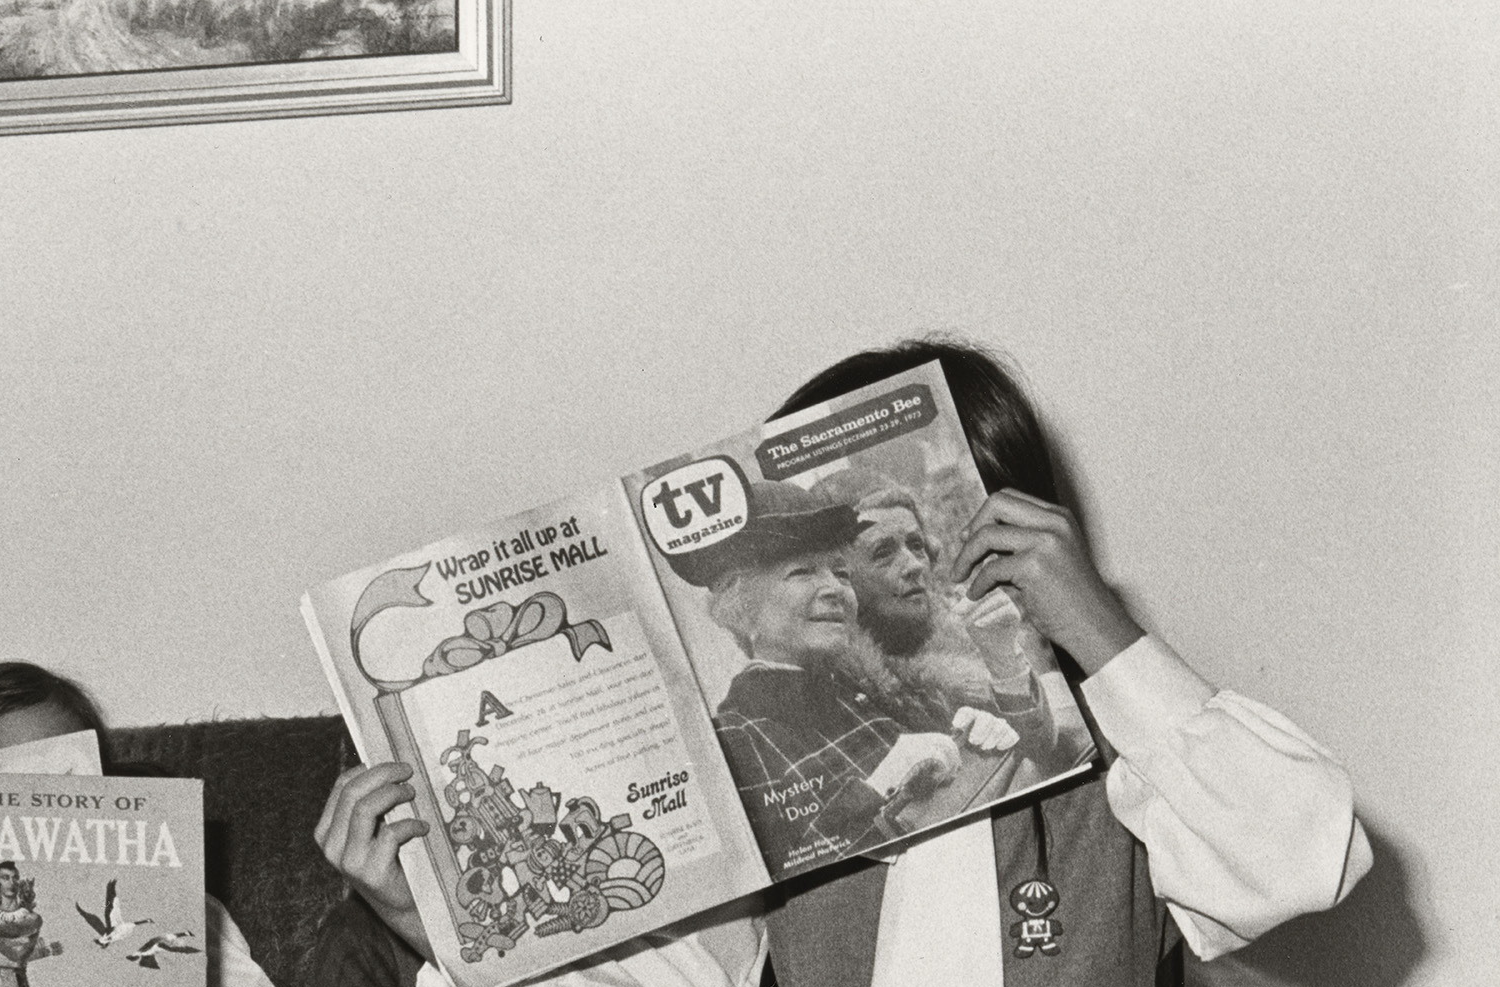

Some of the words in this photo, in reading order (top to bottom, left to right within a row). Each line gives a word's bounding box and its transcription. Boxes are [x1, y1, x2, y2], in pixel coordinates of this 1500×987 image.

[767, 441, 799, 460] The
[799, 408, 890, 448] Sacramento
[891, 395, 922, 414] Bee
[776, 453, 811, 470] PROGRAM
[812, 440, 843, 457] LISTINGS
[843, 428, 878, 446] DECEMBER
[904, 410, 923, 425] 1973
[652, 472, 724, 529] tv
[436, 549, 491, 582] Wrap
[492, 540, 511, 562] it
[511, 529, 535, 555] all
[535, 526, 558, 547] up
[560, 515, 581, 538] at
[666, 515, 743, 550] magazine
[455, 555, 550, 605] SUNRISE
[549, 536, 608, 572] MALL
[30, 792, 103, 810] STORY
[115, 796, 147, 812] OF
[626, 770, 689, 804] Sunrise
[642, 788, 688, 820] Mall
[763, 775, 824, 807] Mystery
[785, 802, 820, 821] Duo
[783, 851, 816, 870] Mildred
